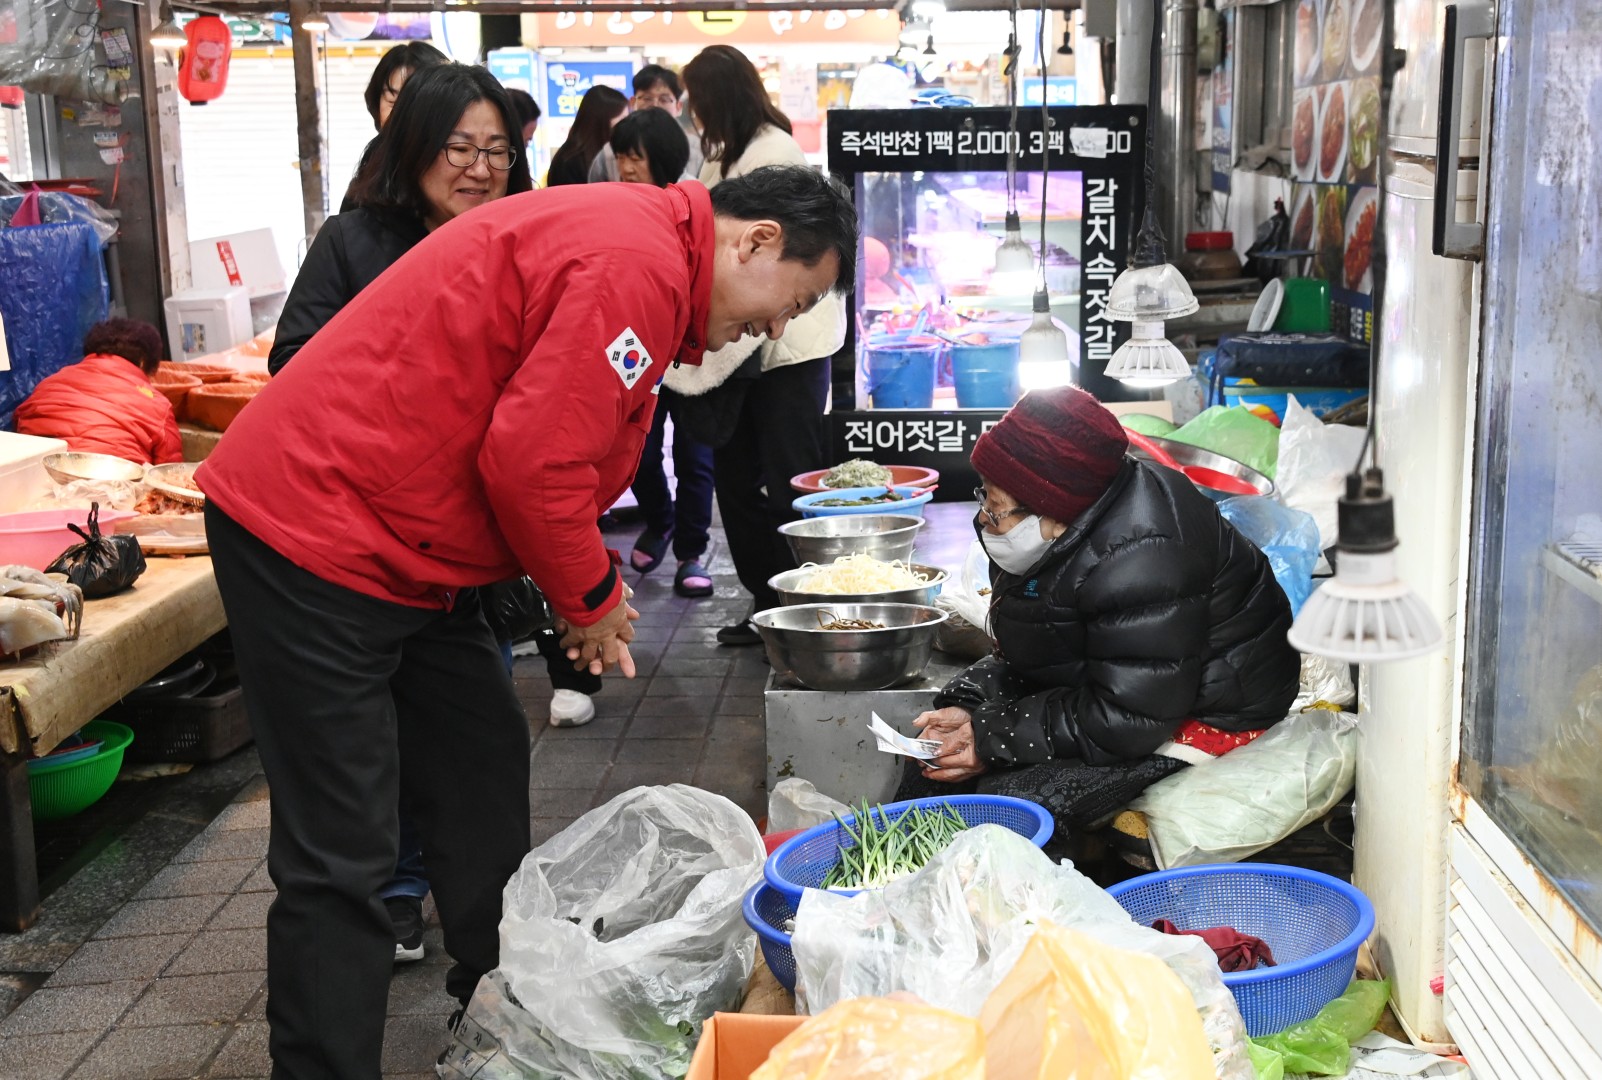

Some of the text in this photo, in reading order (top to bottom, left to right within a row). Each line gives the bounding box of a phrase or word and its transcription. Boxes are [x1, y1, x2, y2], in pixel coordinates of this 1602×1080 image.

[841, 131, 921, 156] 즉석반찬
[925, 131, 953, 155] 1팩
[1085, 178, 1118, 359] 갈치속젓갈
